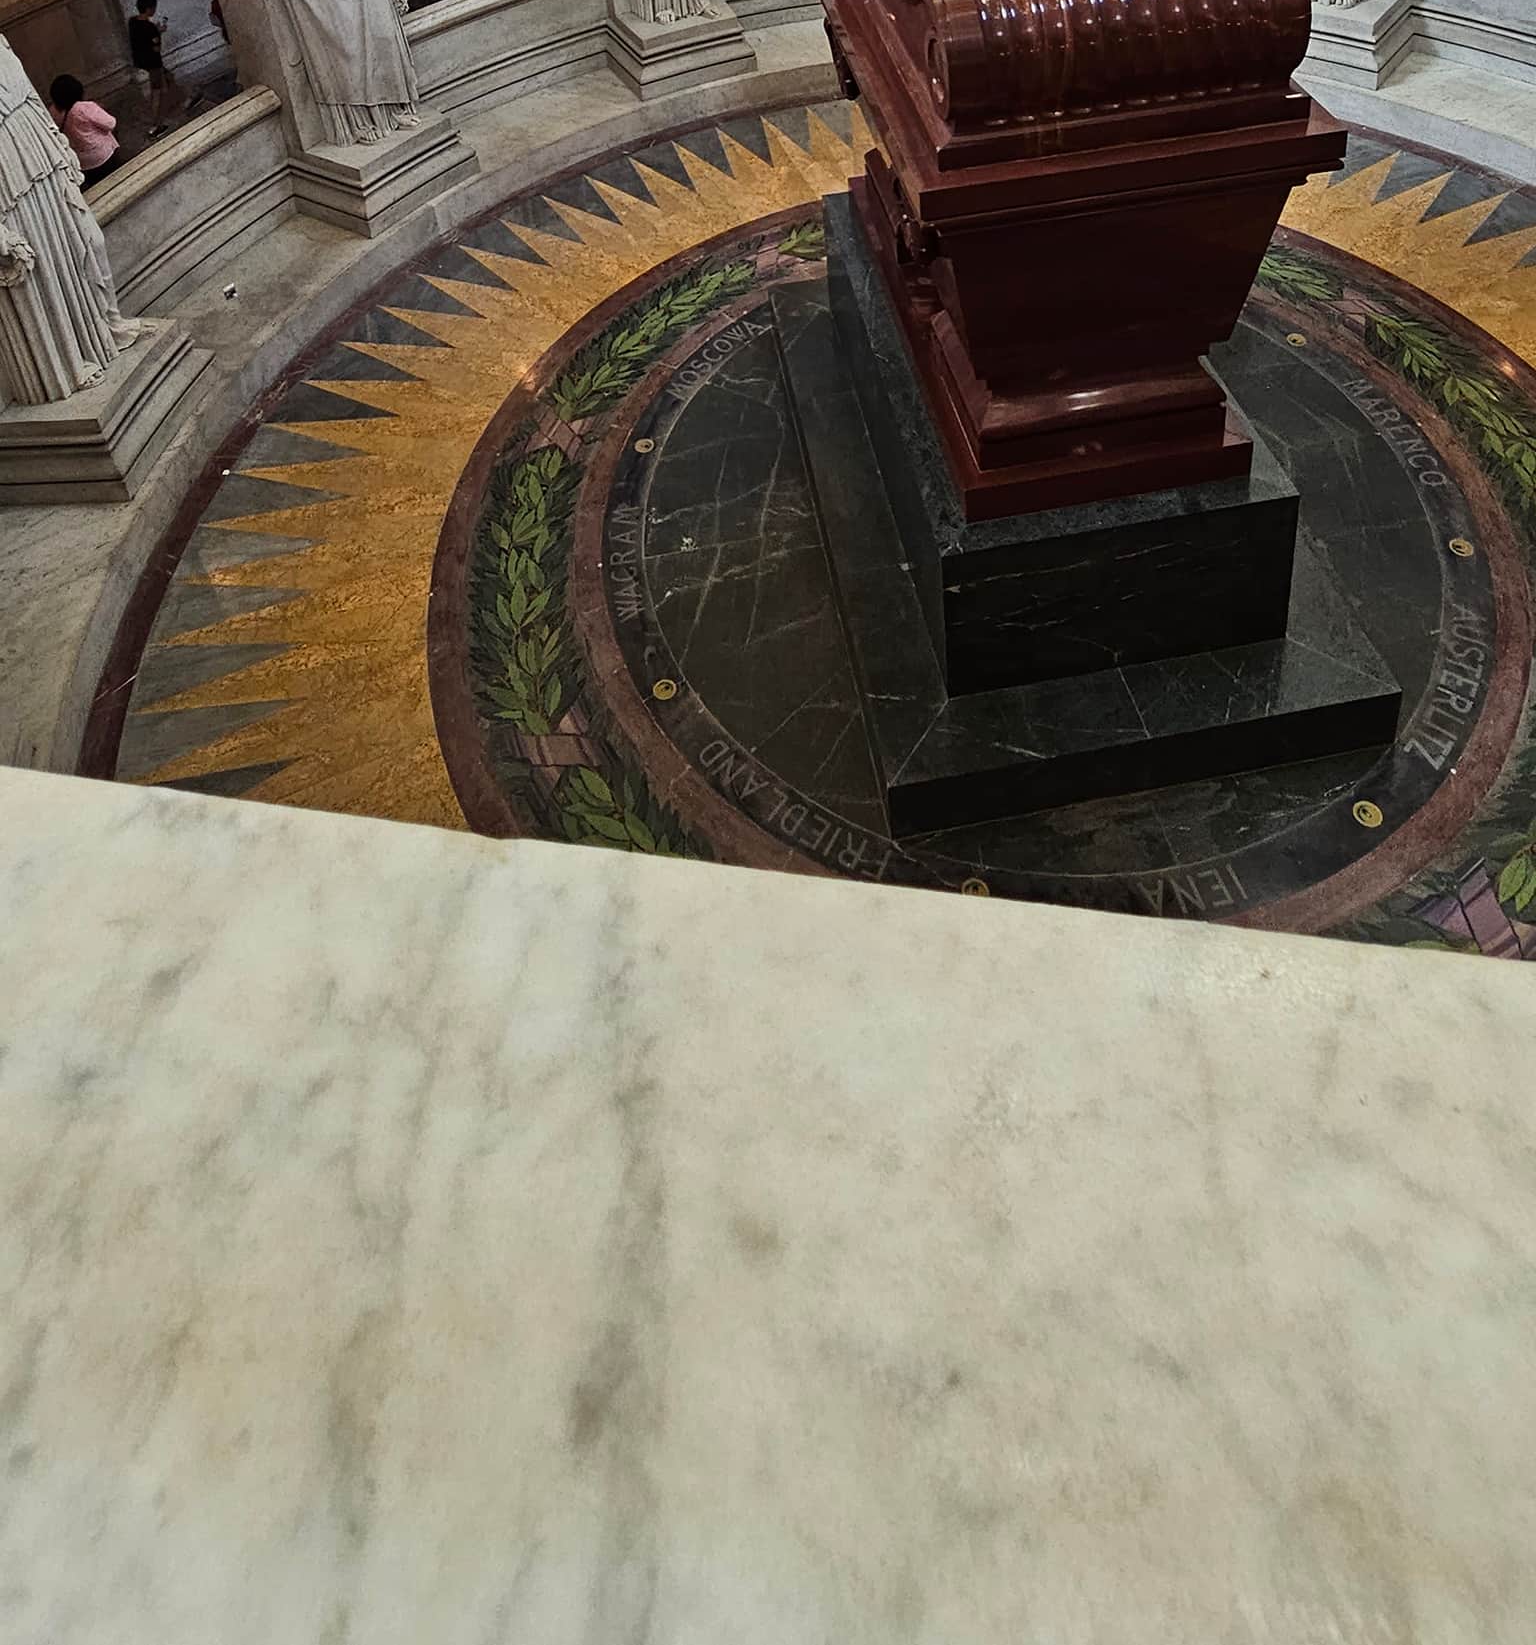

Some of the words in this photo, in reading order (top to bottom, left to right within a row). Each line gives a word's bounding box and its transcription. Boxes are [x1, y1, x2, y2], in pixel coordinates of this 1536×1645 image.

[666, 320, 765, 401] MOSCOWA
[1403, 603, 1488, 770] AUSTERLITZ
[700, 740, 894, 879] FRIEDLAND
[1137, 863, 1249, 917] IENA
